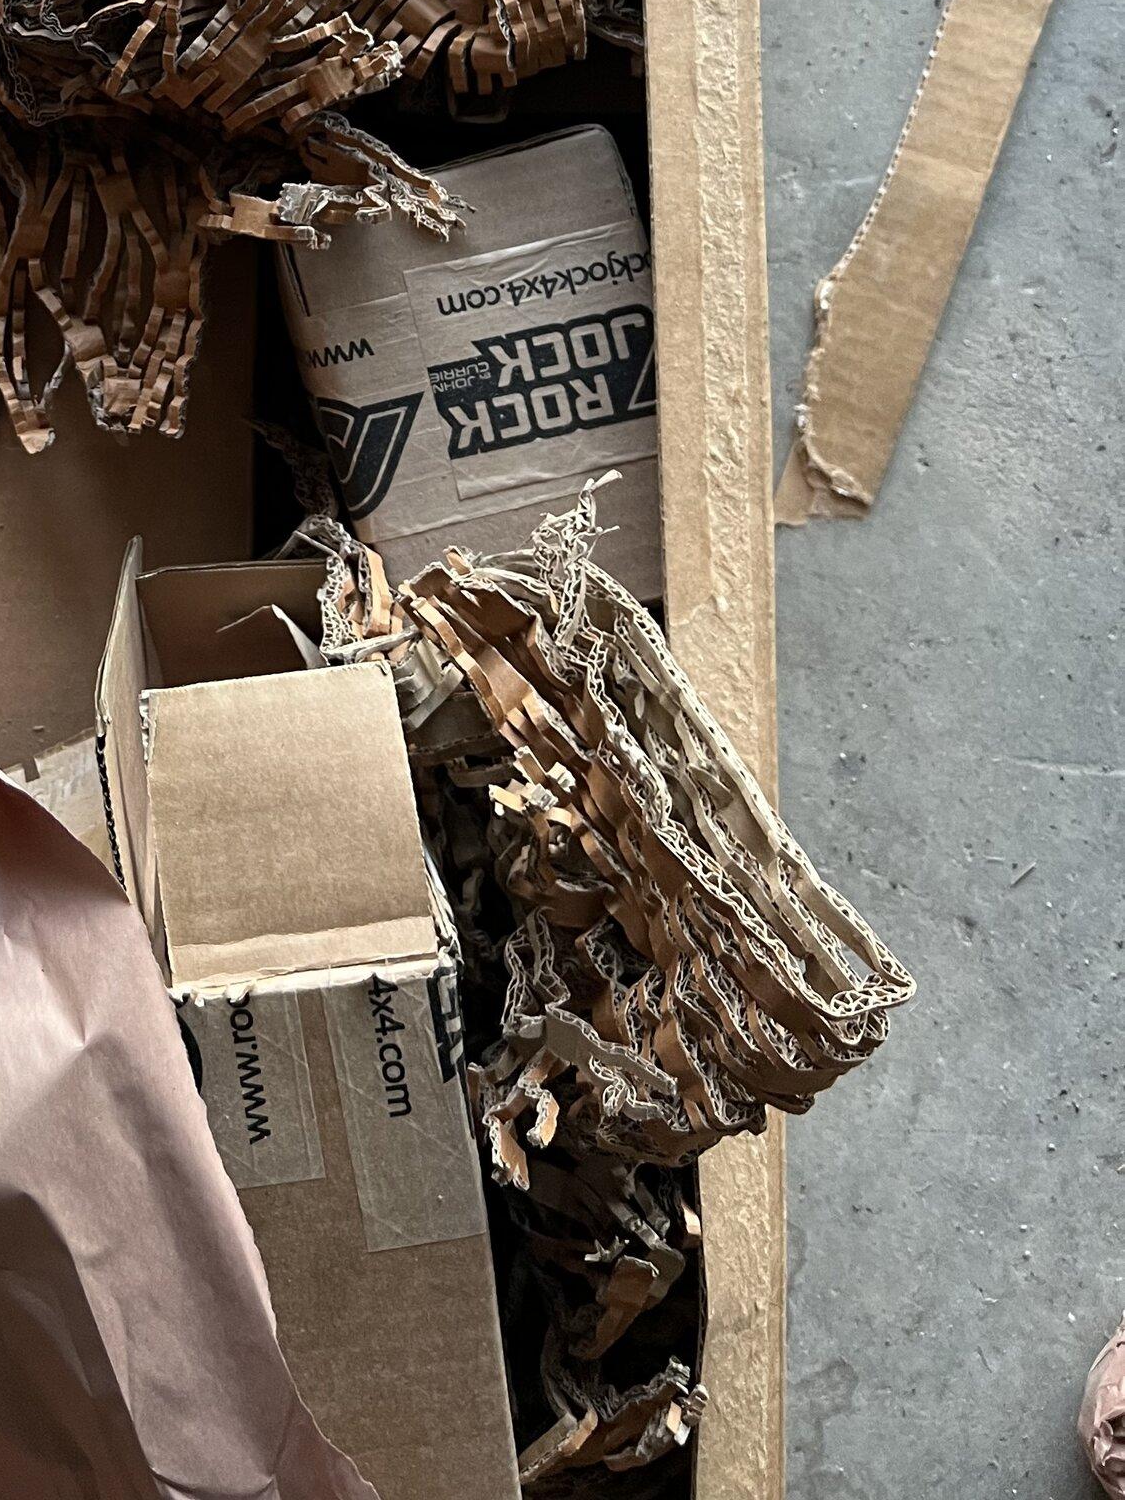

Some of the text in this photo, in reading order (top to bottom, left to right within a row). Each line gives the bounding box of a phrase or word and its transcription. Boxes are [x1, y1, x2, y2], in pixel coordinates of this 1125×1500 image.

[429, 361, 490, 384] CURRIE
[487, 312, 647, 388] JOCK
[433, 375, 476, 394] JOHN
[447, 372, 615, 450] ROCK
